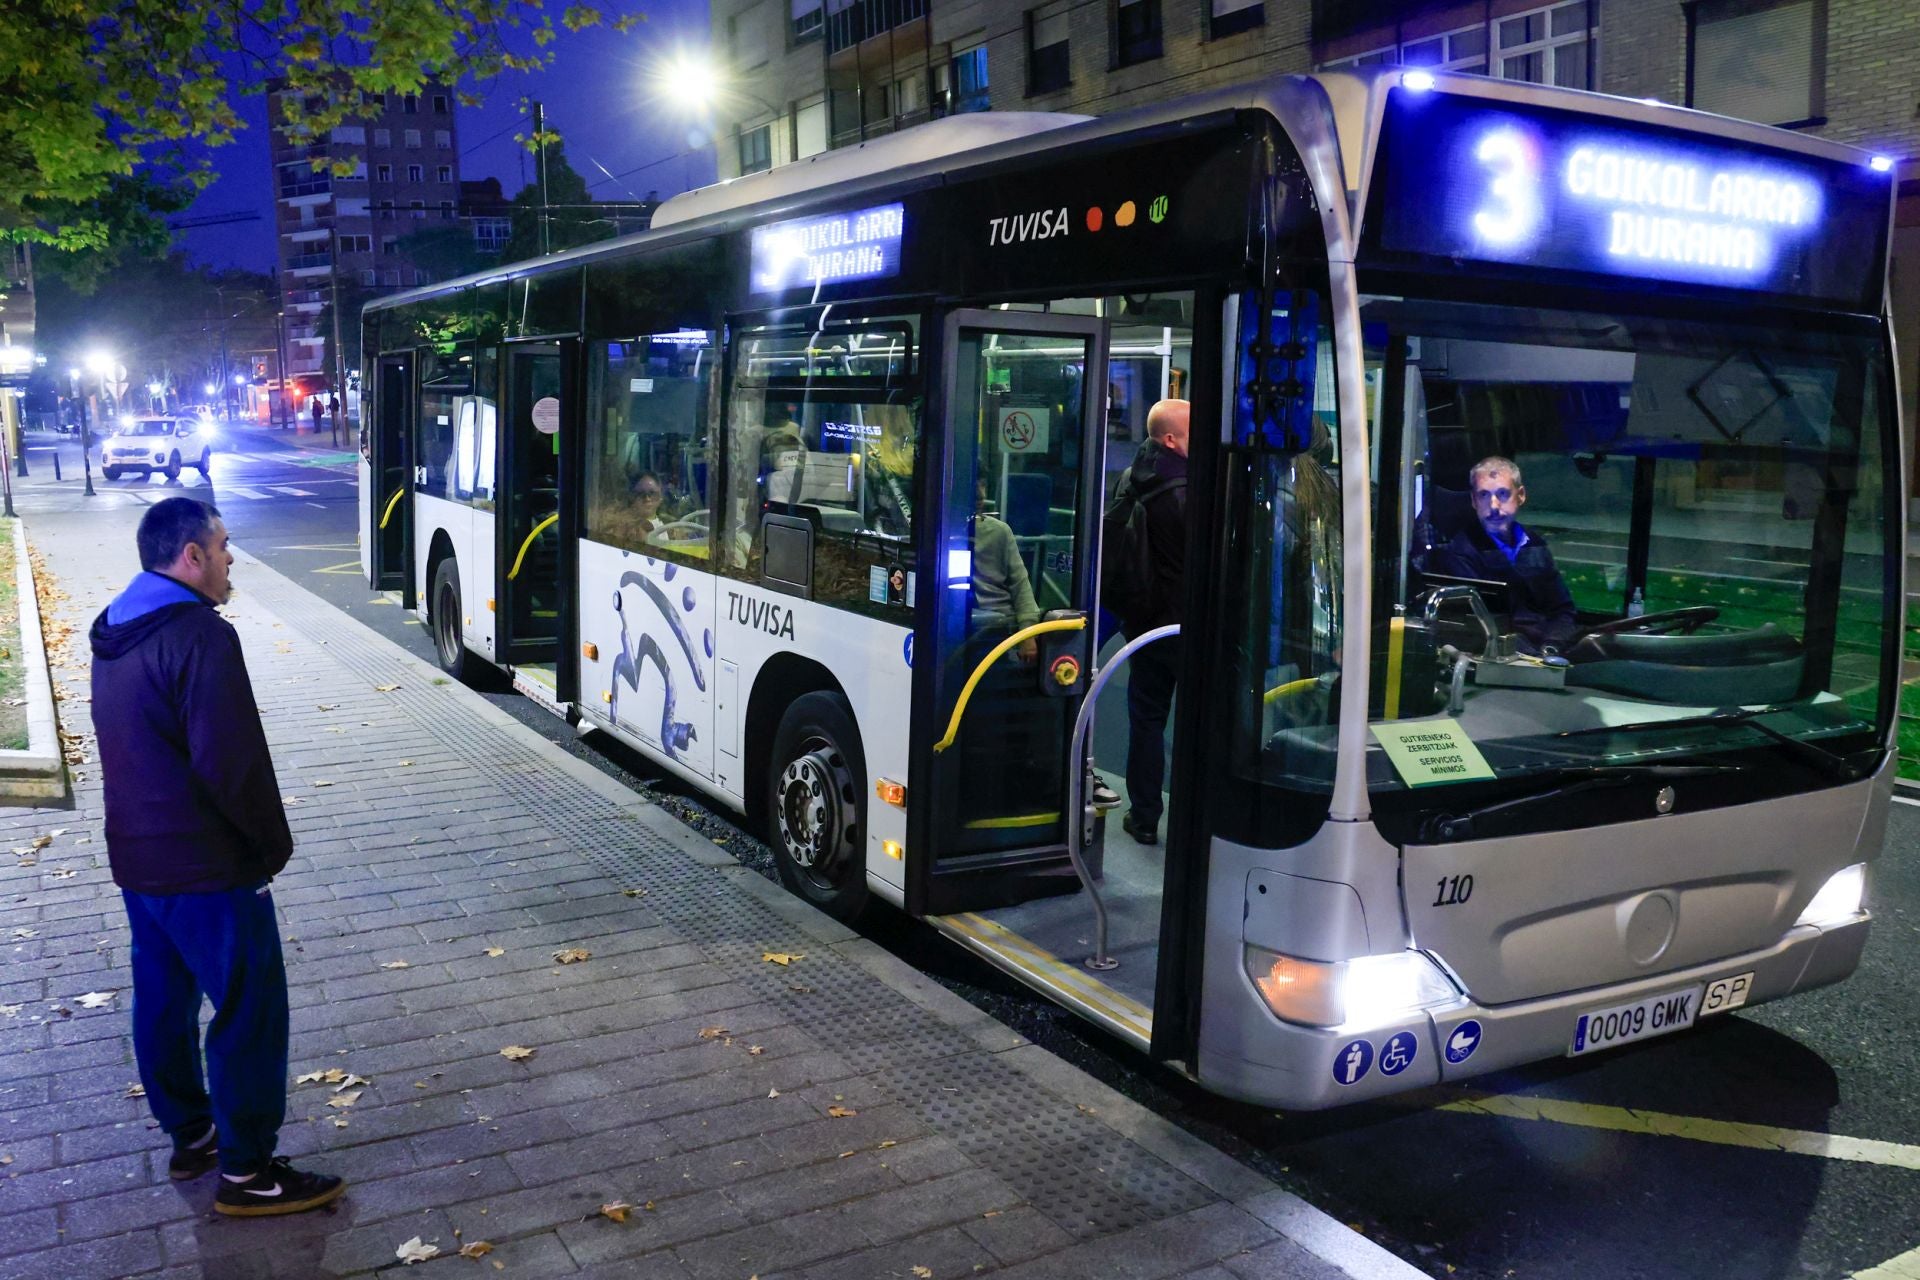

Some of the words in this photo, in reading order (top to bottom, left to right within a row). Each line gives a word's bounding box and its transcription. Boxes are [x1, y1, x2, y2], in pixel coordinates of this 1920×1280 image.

[1475, 127, 1531, 247] 3
[1566, 146, 1806, 225] GOIKOLARRA
[989, 207, 1069, 246] TUVISA
[1607, 211, 1757, 269] DURANA
[728, 591, 795, 641] TUVISA
[1400, 733, 1451, 743] GUTXIENEKO
[1407, 742, 1458, 753] ZERBITZUAK
[1419, 755, 1463, 766] SERVICIOS
[1433, 874, 1474, 907] 110
[1708, 978, 1747, 1010] SP
[1590, 1006, 1645, 1044] 0009
[1652, 994, 1692, 1029] GMK
